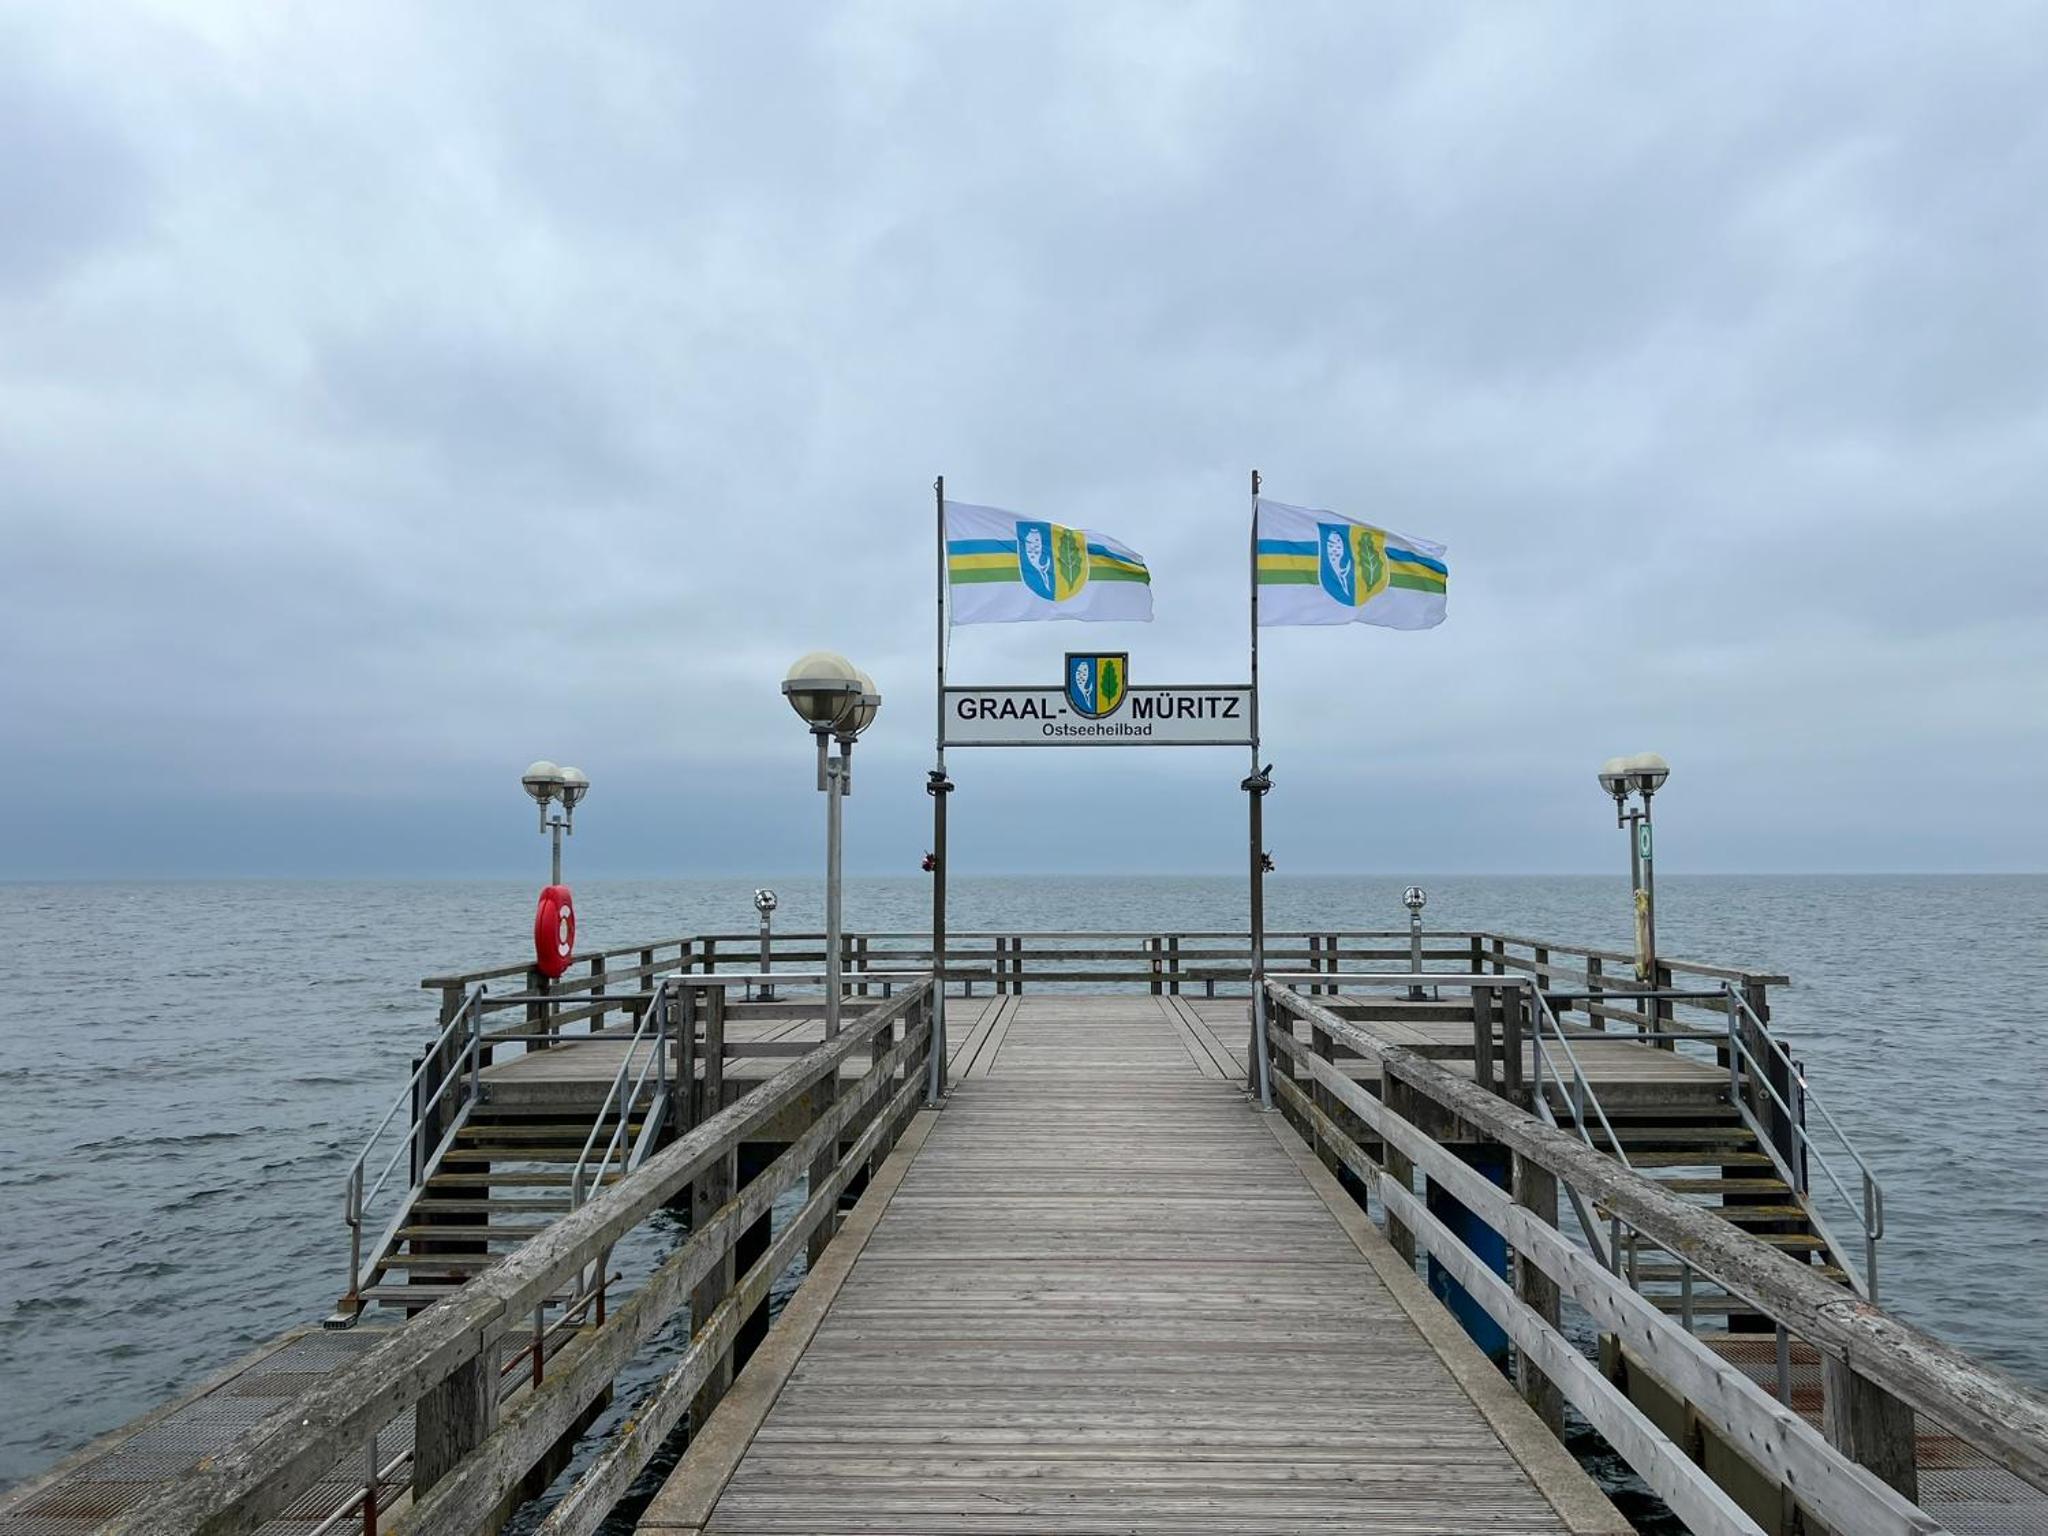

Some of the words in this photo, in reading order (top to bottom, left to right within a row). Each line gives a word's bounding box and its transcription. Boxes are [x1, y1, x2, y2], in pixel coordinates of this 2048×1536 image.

[957, 697, 1067, 720] GRAAL-
[1131, 692, 1240, 719] MÜRITZ
[1042, 722, 1152, 737] Ostseeheilbad
